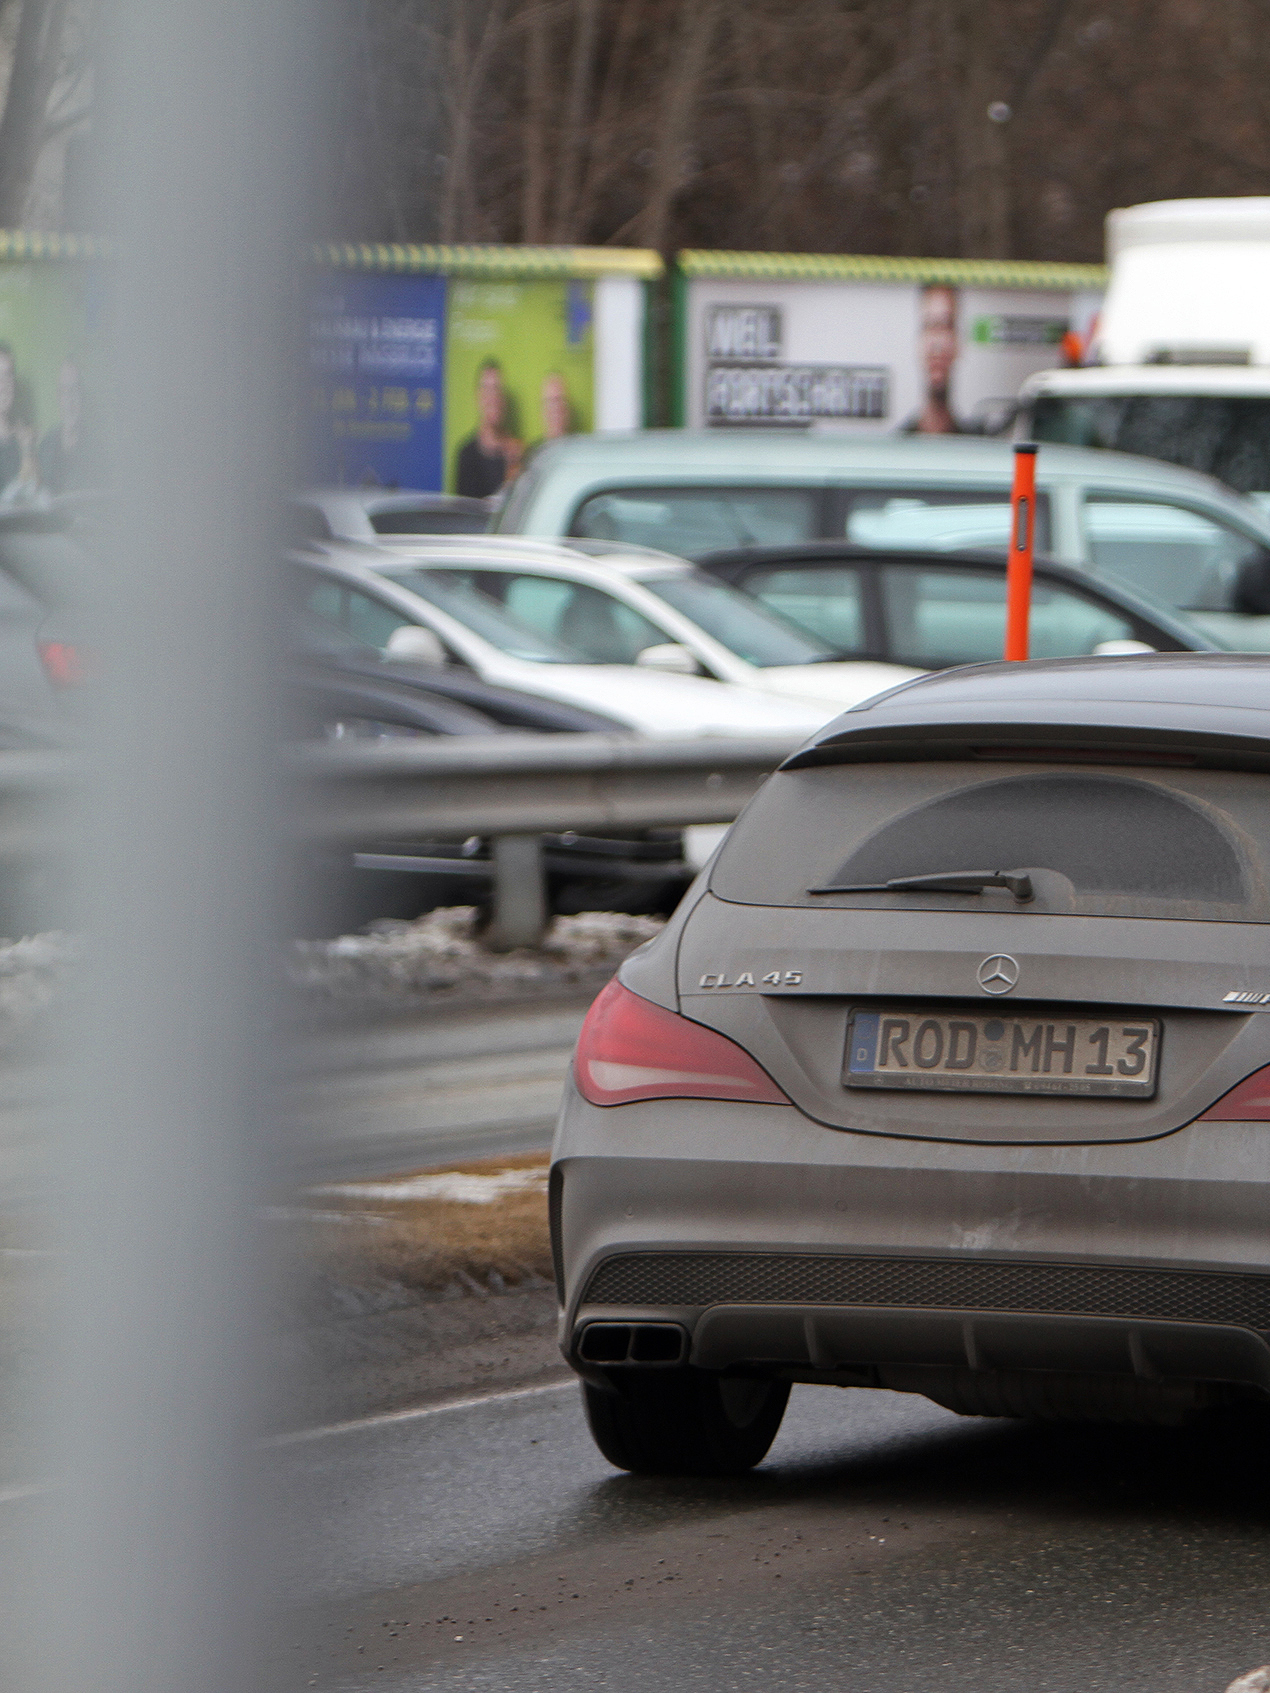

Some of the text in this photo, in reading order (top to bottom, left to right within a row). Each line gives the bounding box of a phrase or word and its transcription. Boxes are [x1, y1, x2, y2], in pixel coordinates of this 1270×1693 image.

[699, 970, 803, 988] CLA 45
[855, 1047, 868, 1062] D
[878, 1018, 1150, 1076] ROD MH 13
